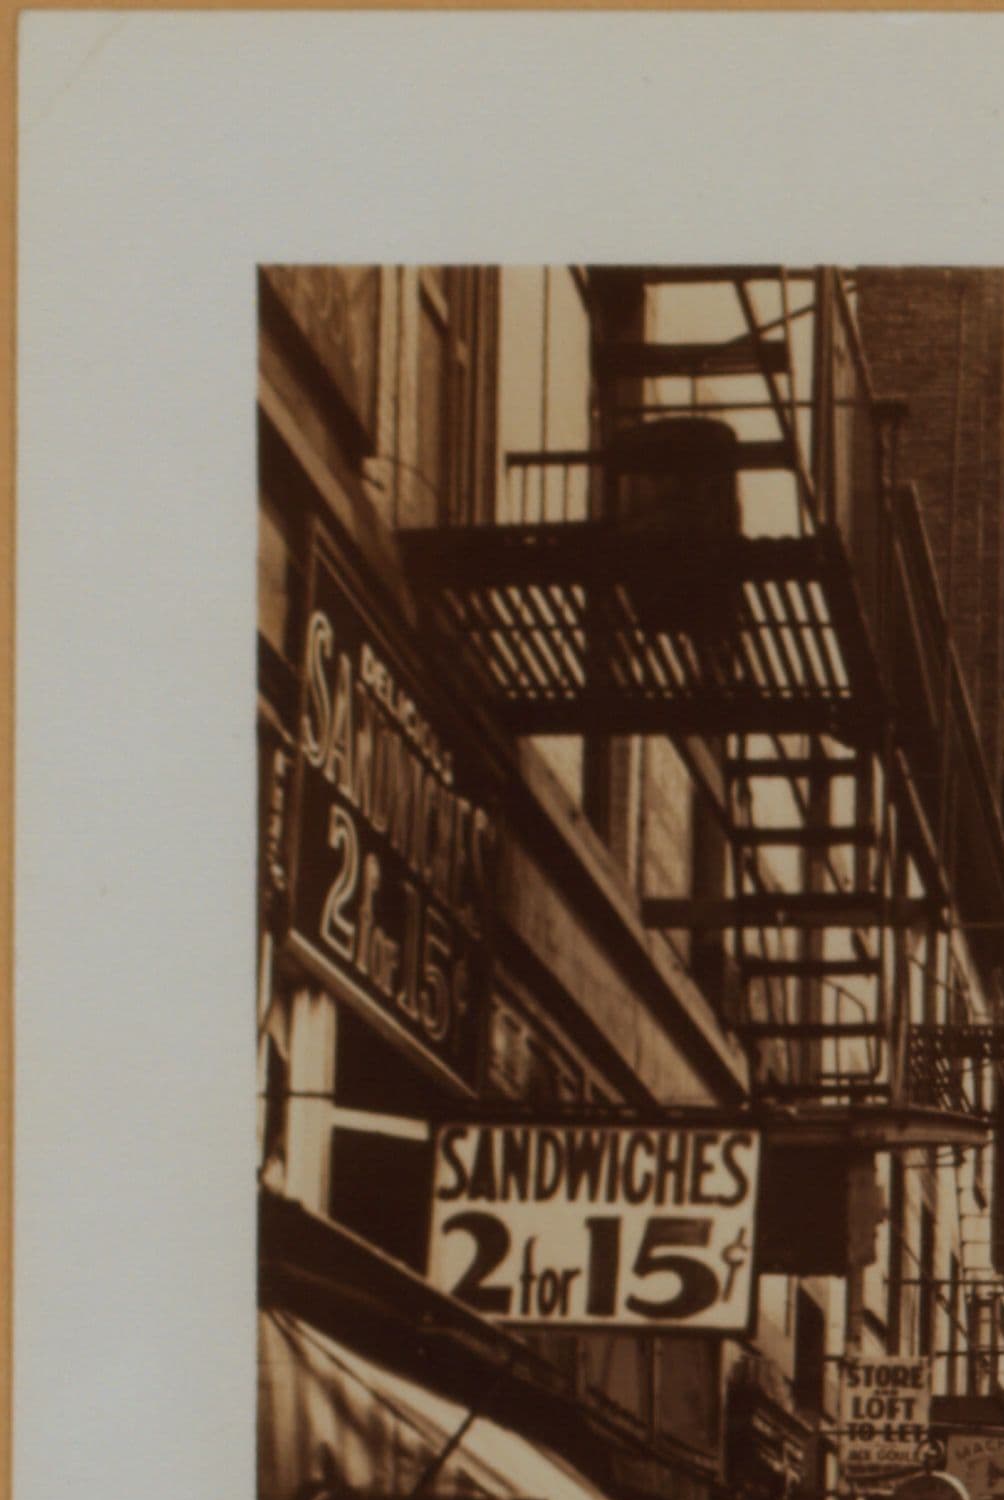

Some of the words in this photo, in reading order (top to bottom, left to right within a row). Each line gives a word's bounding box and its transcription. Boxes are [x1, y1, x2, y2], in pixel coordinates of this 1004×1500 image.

[321, 803, 357, 962] 2
[436, 1127, 753, 1208] SANDWICHES
[441, 1210, 512, 1315] 2
[520, 1235, 582, 1317] for
[846, 1364, 924, 1389] STORE
[847, 1423, 876, 1442] TO
[883, 1423, 924, 1443] LET
[852, 1396, 916, 1420] LOFT
